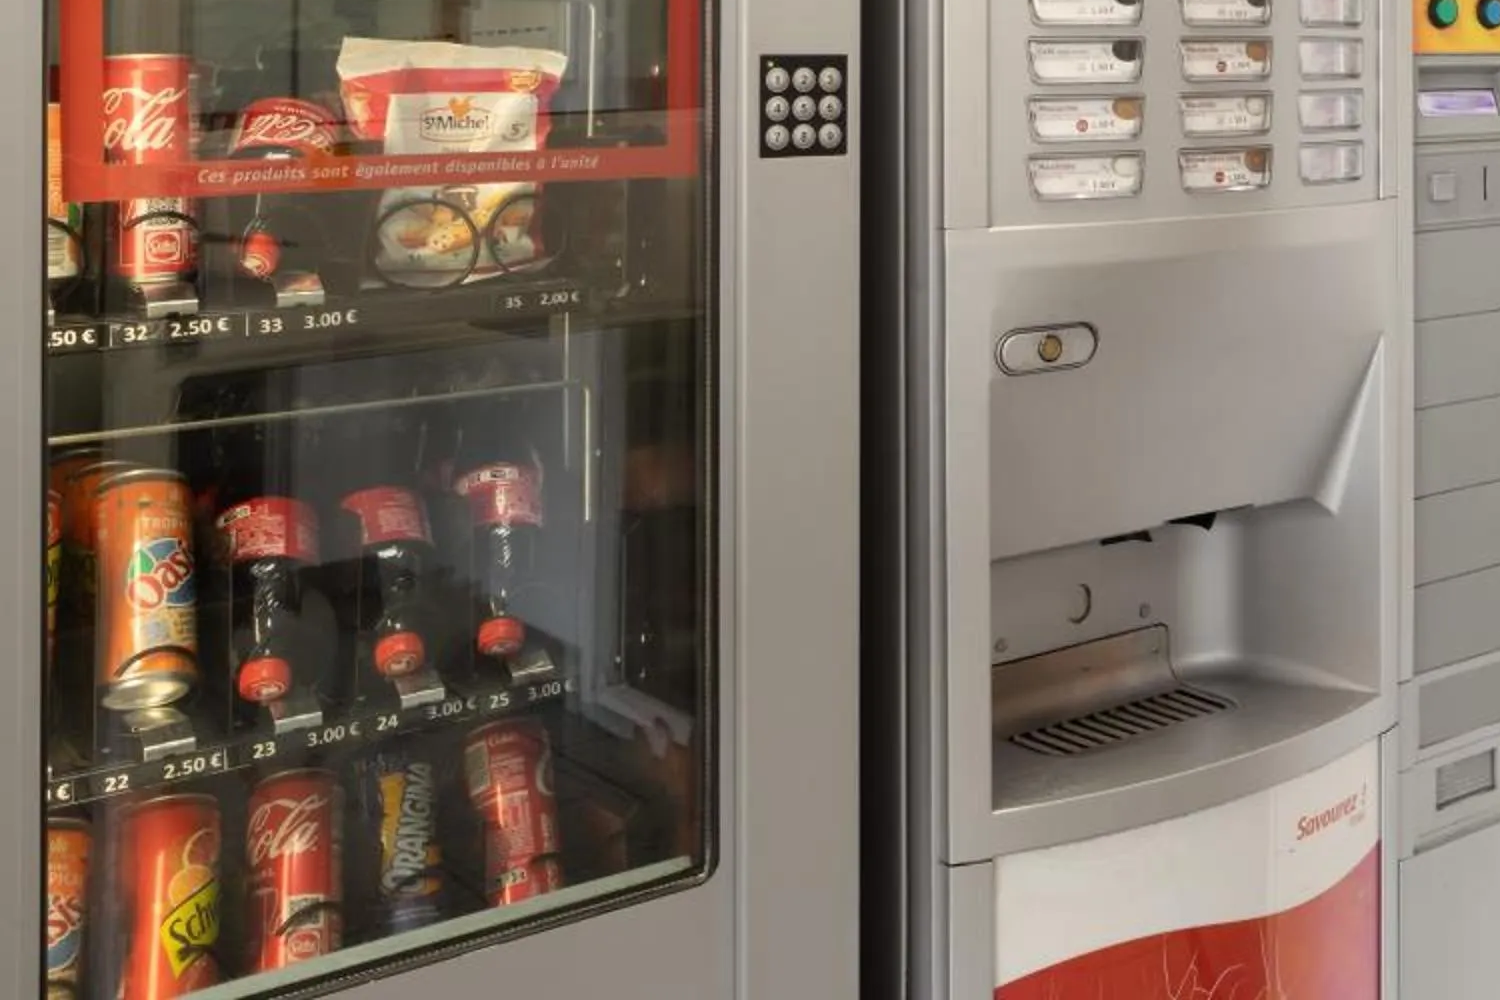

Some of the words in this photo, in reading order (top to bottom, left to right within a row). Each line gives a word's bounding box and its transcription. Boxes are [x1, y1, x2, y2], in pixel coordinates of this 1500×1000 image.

[198, 168, 226, 184] Ces
[232, 164, 305, 186] produits
[311, 163, 349, 180] sont
[355, 159, 439, 178] également
[445, 157, 532, 177] disponibles
[536, 156, 545, 170] à
[550, 154, 600, 170] l'unité
[505, 295, 523, 309] 35
[538, 291, 570, 307] 2.00
[571, 289, 581, 303] €
[47, 330, 77, 347] .50
[82, 328, 96, 345] €
[123, 325, 148, 342] 32
[170, 319, 213, 338] 2.50
[216, 316, 230, 332] €
[259, 318, 284, 334] 33
[303, 311, 342, 329] 3.00
[345, 308, 358, 324] €
[56, 784, 71, 800] €
[105, 774, 130, 793] 22
[163, 756, 206, 780] 2.50
[210, 751, 223, 768] €
[252, 741, 277, 759] 23
[306, 724, 346, 747] 3.00
[349, 721, 361, 736] €
[376, 713, 399, 731] 24
[427, 700, 464, 720] 3.00
[466, 696, 477, 710] €
[489, 694, 511, 710] 25
[527, 681, 561, 700] 3.00
[565, 678, 576, 693] €
[380, 761, 434, 892] ORANGINA
[1296, 793, 1359, 841] Savourez
